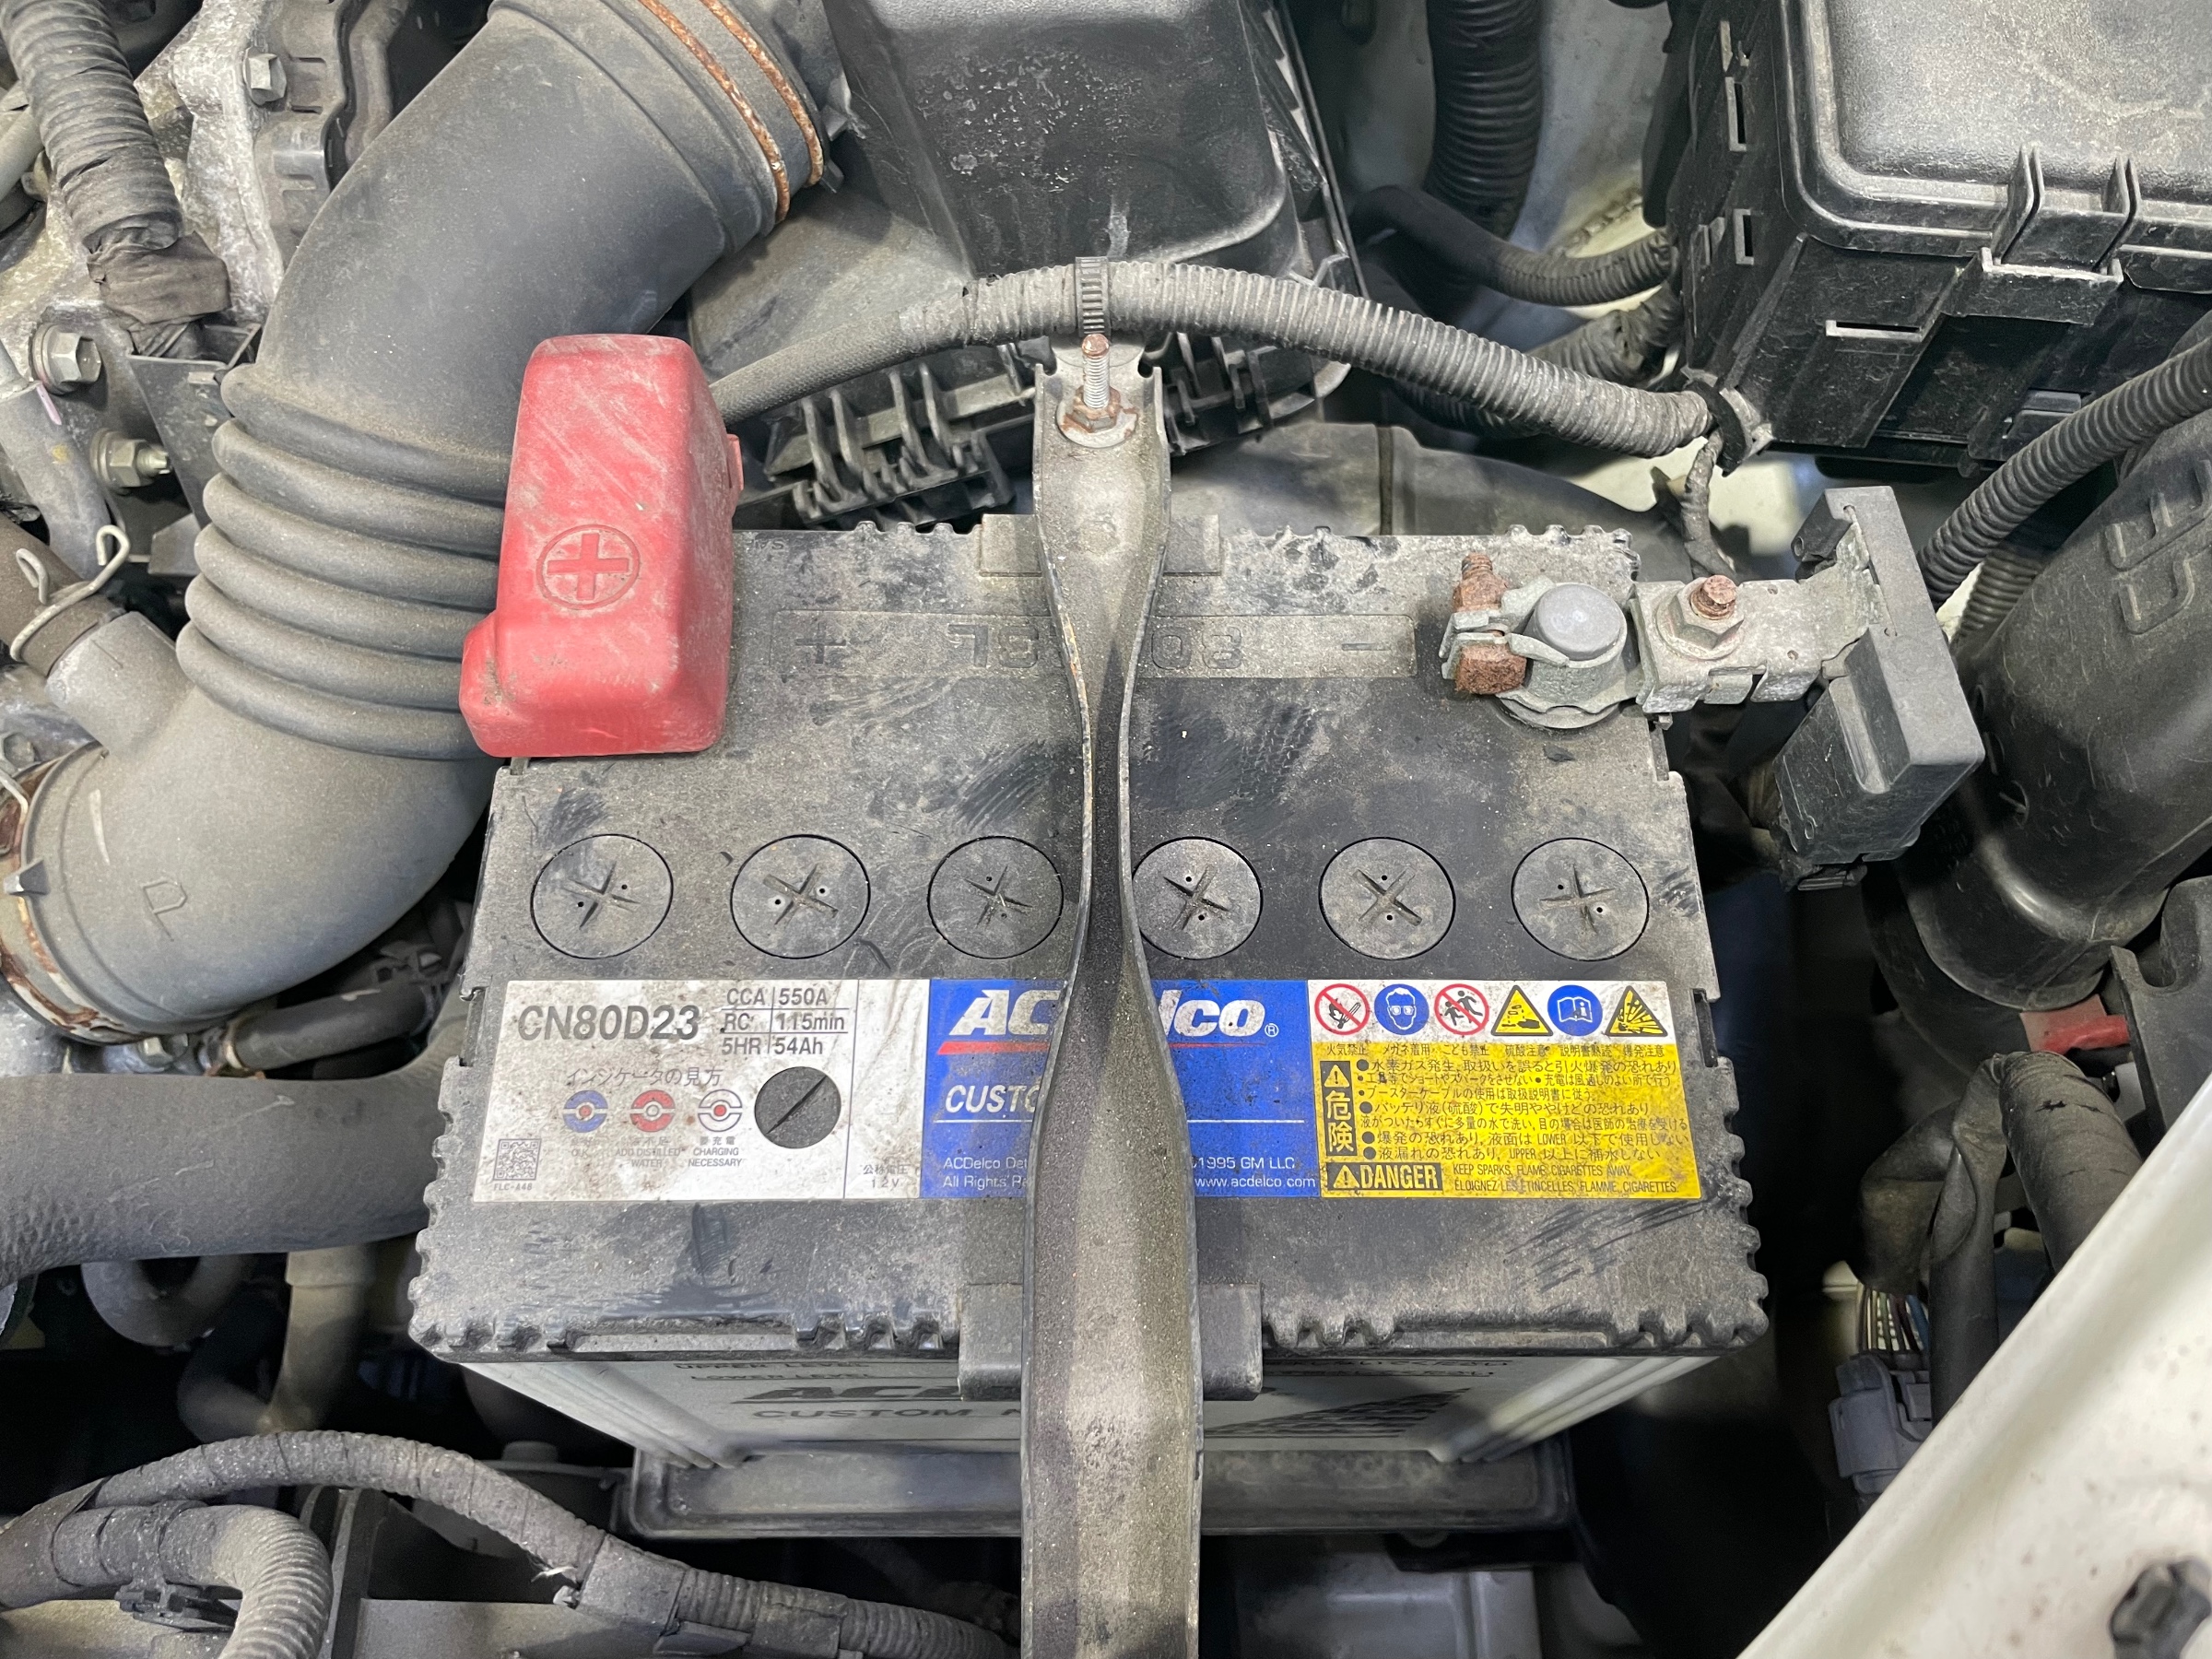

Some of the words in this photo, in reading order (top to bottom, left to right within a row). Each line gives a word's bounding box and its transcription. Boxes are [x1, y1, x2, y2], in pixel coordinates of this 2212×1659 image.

[726, 988, 765, 1006] CCA
[778, 987, 828, 1006] 550A
[517, 1004, 700, 1041] CN80D23
[723, 1013, 753, 1030] RC
[777, 1012, 844, 1030] 115min
[722, 1037, 761, 1055] 5HR
[774, 1037, 823, 1055] 54Ah
[1326, 1043, 1368, 1056] 火気禁止
[1382, 1044, 1430, 1056] メガネ着用
[1442, 1044, 1490, 1057] こども禁止
[1505, 1044, 1546, 1057] 硫酸注意
[1623, 1044, 1665, 1057] 爆発注意
[566, 1066, 724, 1087] インジケータの見方
[945, 1084, 1040, 1113] CUSTO
[1325, 1089, 1354, 1154] 危険
[1536, 1133, 1566, 1146] LOWER
[615, 1148, 634, 1157] ADD
[692, 1147, 739, 1156] CHARGING
[1509, 1148, 1536, 1159] UPPER
[631, 1159, 663, 1168] WATER
[688, 1158, 743, 1167] NECESSARY
[943, 1157, 1000, 1170] ACDelco
[1241, 1157, 1265, 1169] GM
[1269, 1157, 1295, 1169] LLC
[1359, 1164, 1439, 1189] DANGER
[1453, 1164, 1474, 1175] KEEP
[1551, 1165, 1603, 1176] CIGARETTES
[942, 1175, 959, 1188] All
[753, 1408, 972, 1418] CUSTOM
